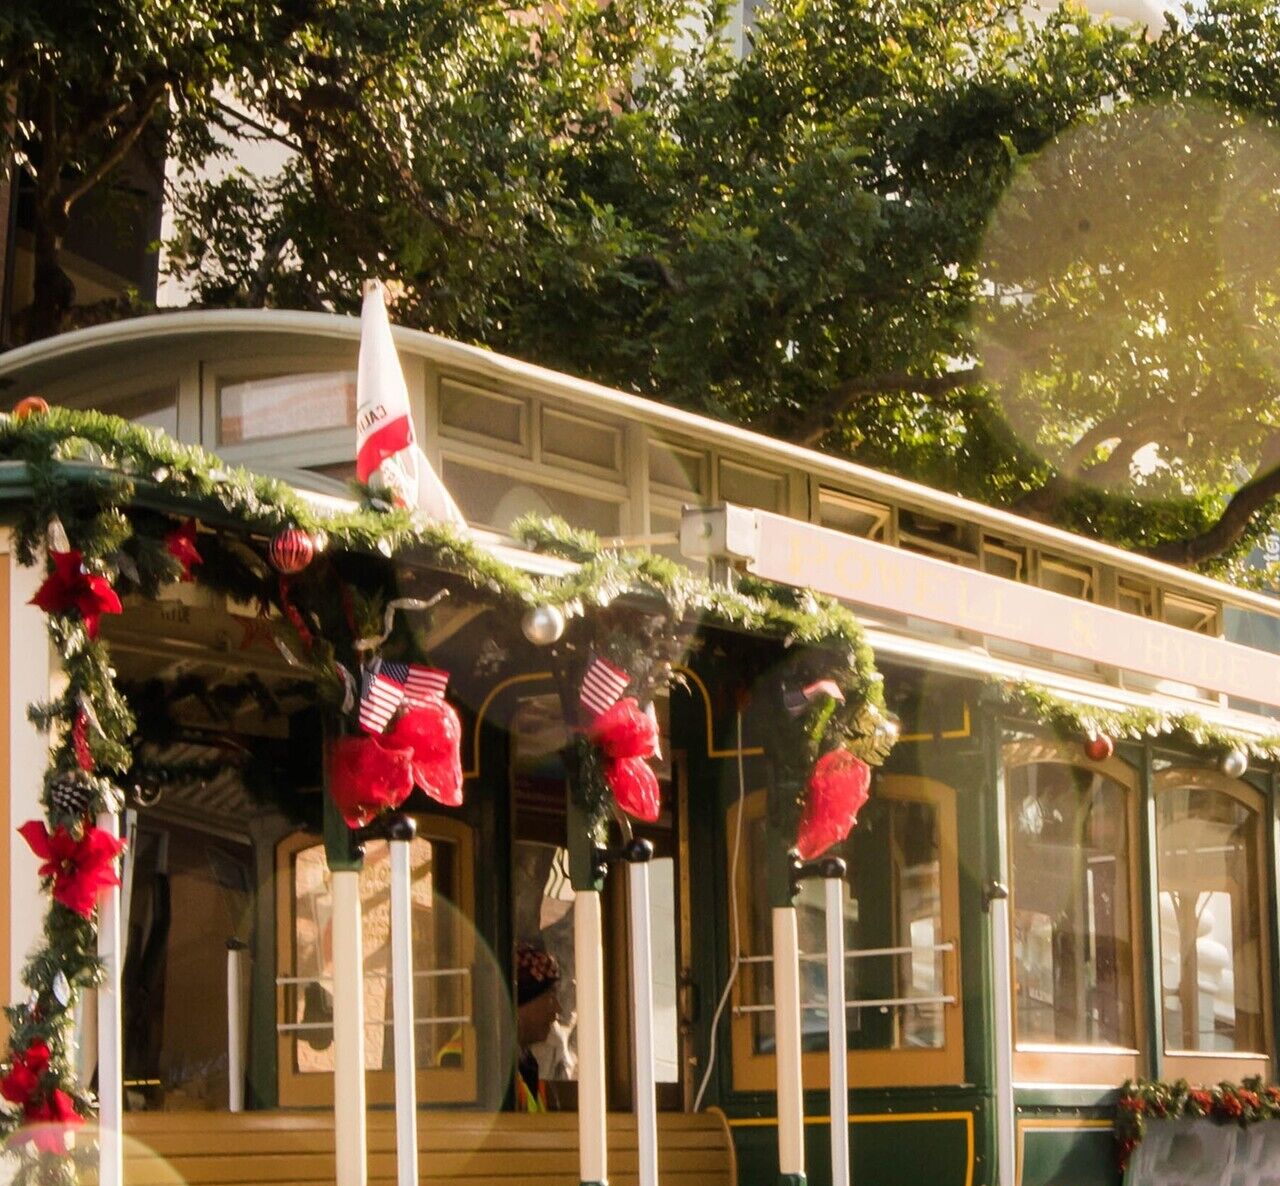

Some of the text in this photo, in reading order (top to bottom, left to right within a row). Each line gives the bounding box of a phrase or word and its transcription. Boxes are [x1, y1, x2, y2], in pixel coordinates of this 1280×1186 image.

[786, 534, 1024, 632] POWELL
[1070, 612, 1099, 650] &
[1144, 632, 1251, 689] HYDE
